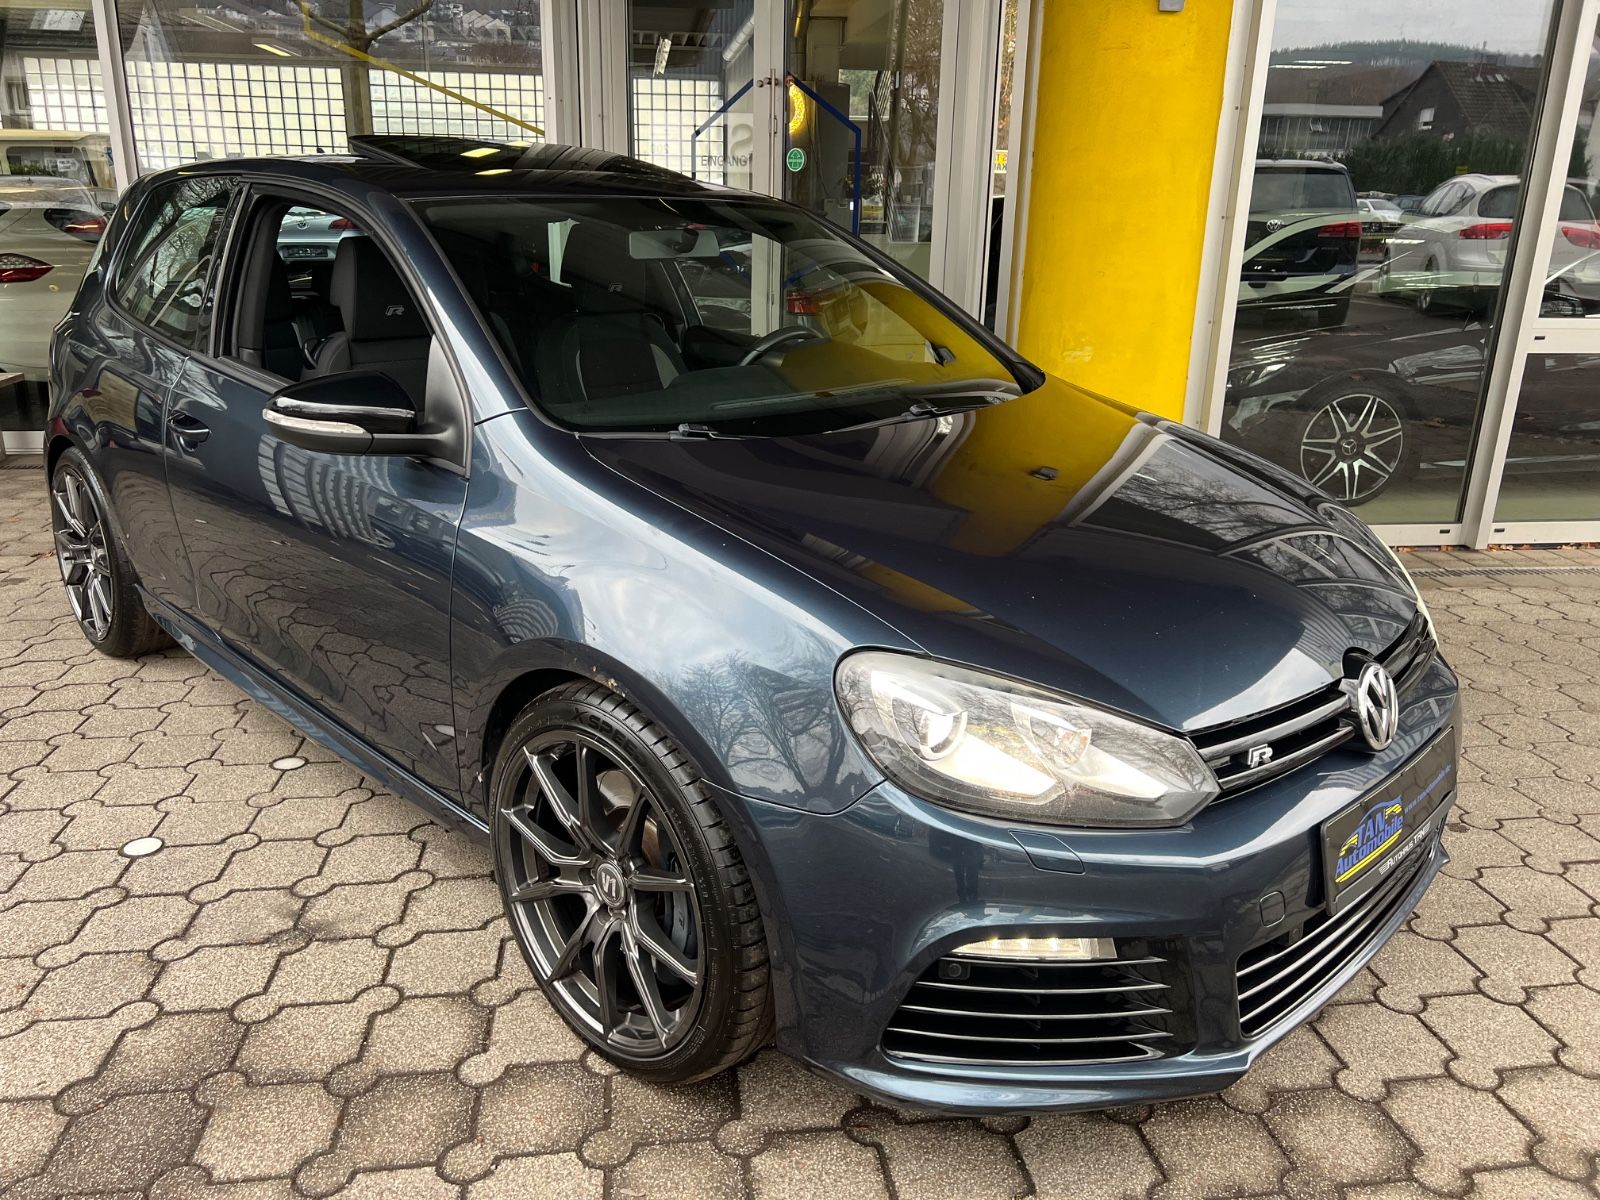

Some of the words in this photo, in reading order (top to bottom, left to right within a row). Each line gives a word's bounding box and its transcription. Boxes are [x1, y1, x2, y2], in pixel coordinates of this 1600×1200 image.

[701, 155, 748, 167] EINGANG
[385, 304, 405, 316] R
[1248, 743, 1273, 768] R
[1355, 810, 1386, 848] TAN
[1335, 815, 1404, 879] Automobile
